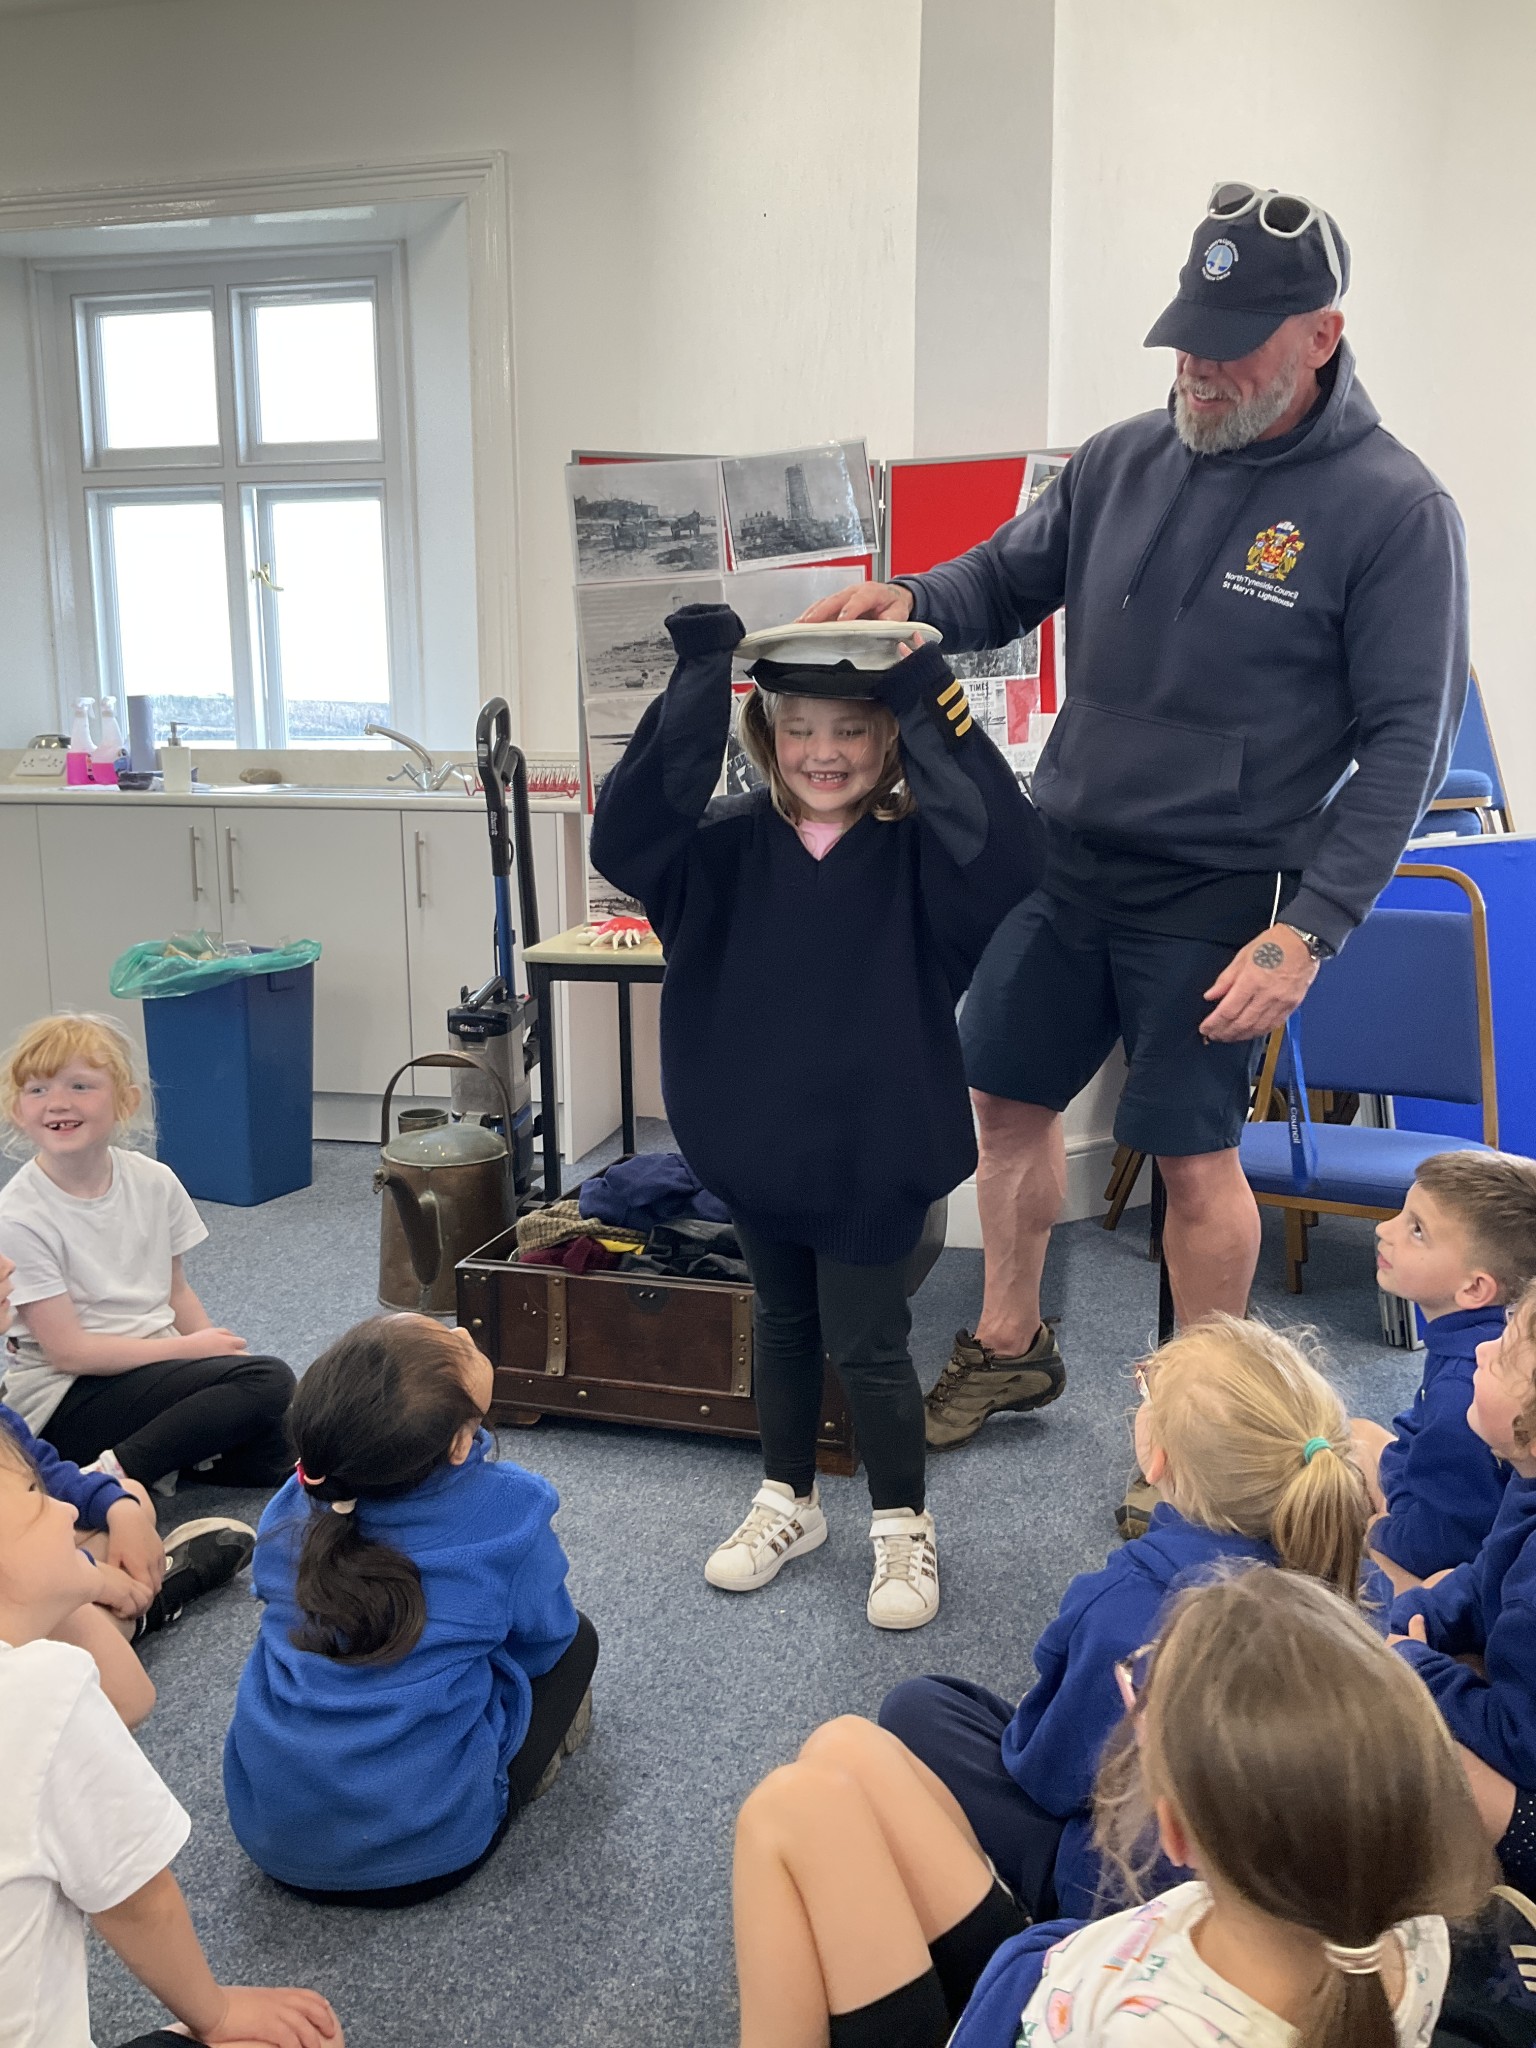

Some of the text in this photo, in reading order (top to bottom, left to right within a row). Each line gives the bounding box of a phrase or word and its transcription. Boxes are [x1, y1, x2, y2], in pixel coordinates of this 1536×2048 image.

[1222, 581, 1295, 608] St Mary's Lighthouse
[1225, 572, 1299, 599] North Tyneside Council
[1291, 1107, 1301, 1143] Council
